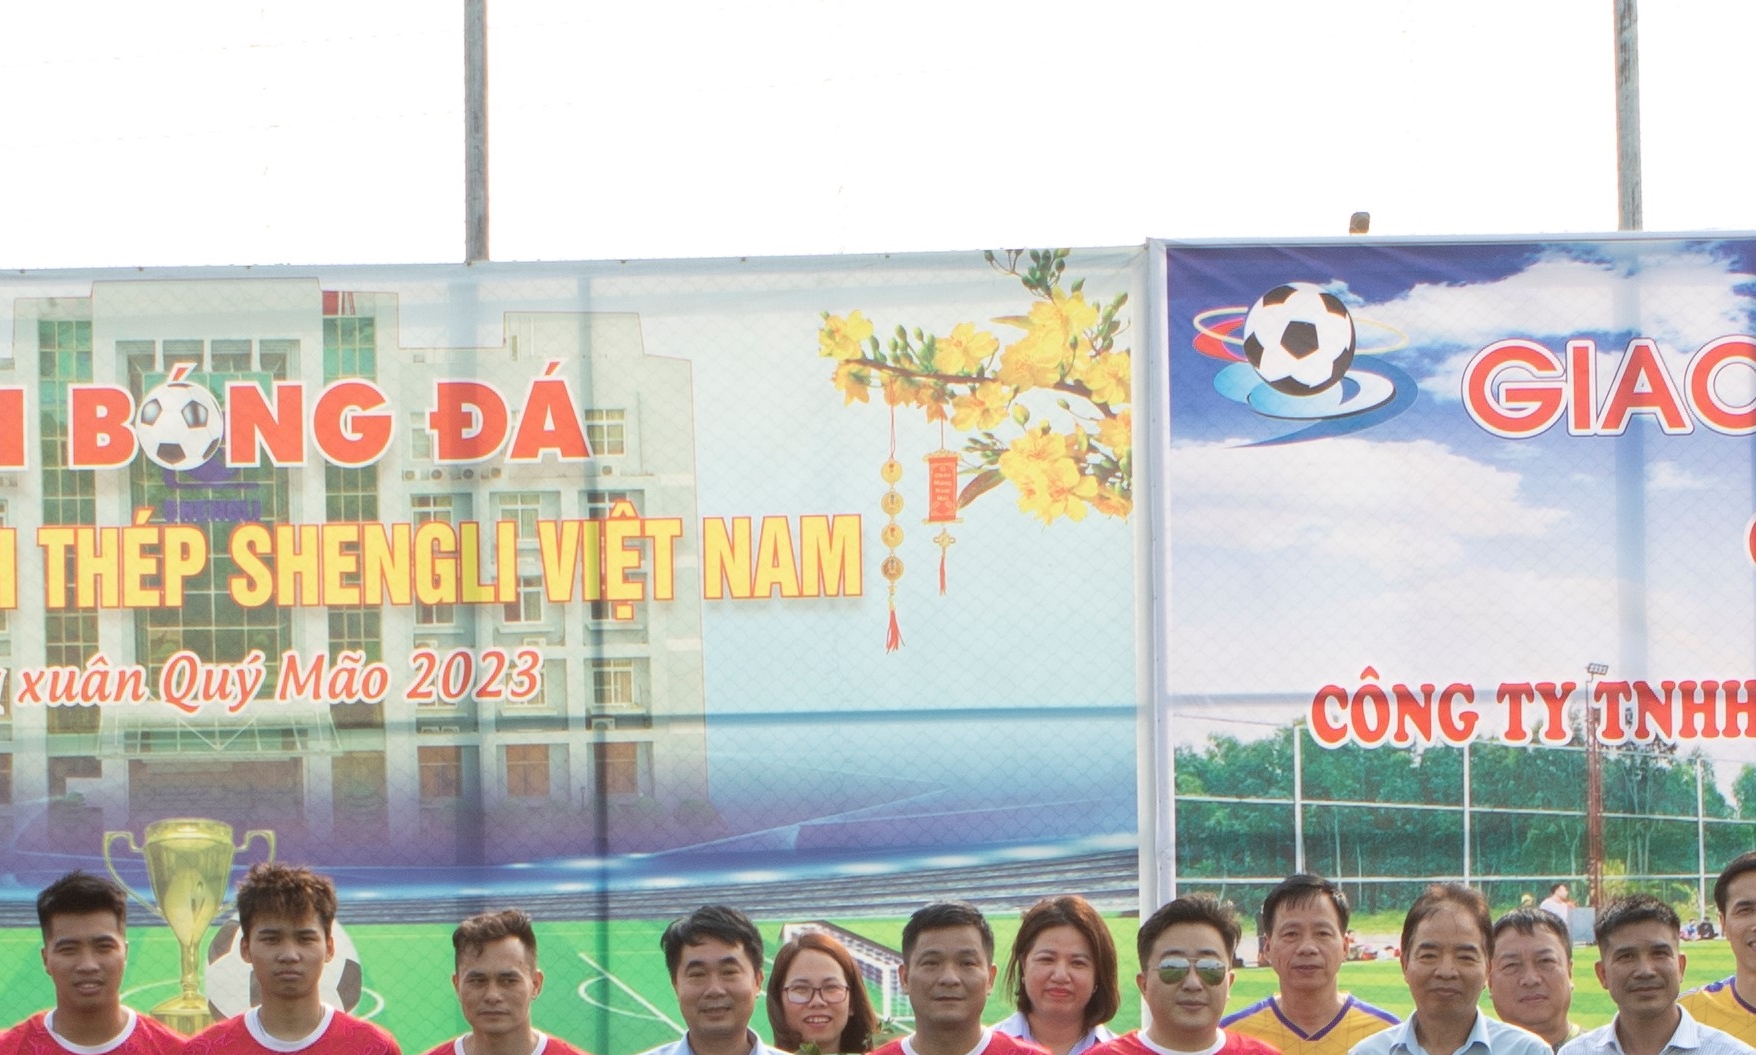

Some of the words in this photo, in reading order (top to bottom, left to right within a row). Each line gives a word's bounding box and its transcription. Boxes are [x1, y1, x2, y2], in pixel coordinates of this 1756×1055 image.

[72, 364, 393, 469] BÓNG
[430, 362, 590, 462] ĐÁ
[38, 507, 206, 609] THÉP
[229, 519, 518, 607] SHENGLI
[540, 500, 683, 620] VIỆT
[704, 513, 864, 599] NAM
[17, 656, 148, 706] xuân
[160, 651, 262, 714] Quý
[276, 652, 389, 702] Mão
[406, 649, 543, 702] 2023
[1312, 667, 1477, 744] CÔNG
[1497, 683, 1576, 740] TY
